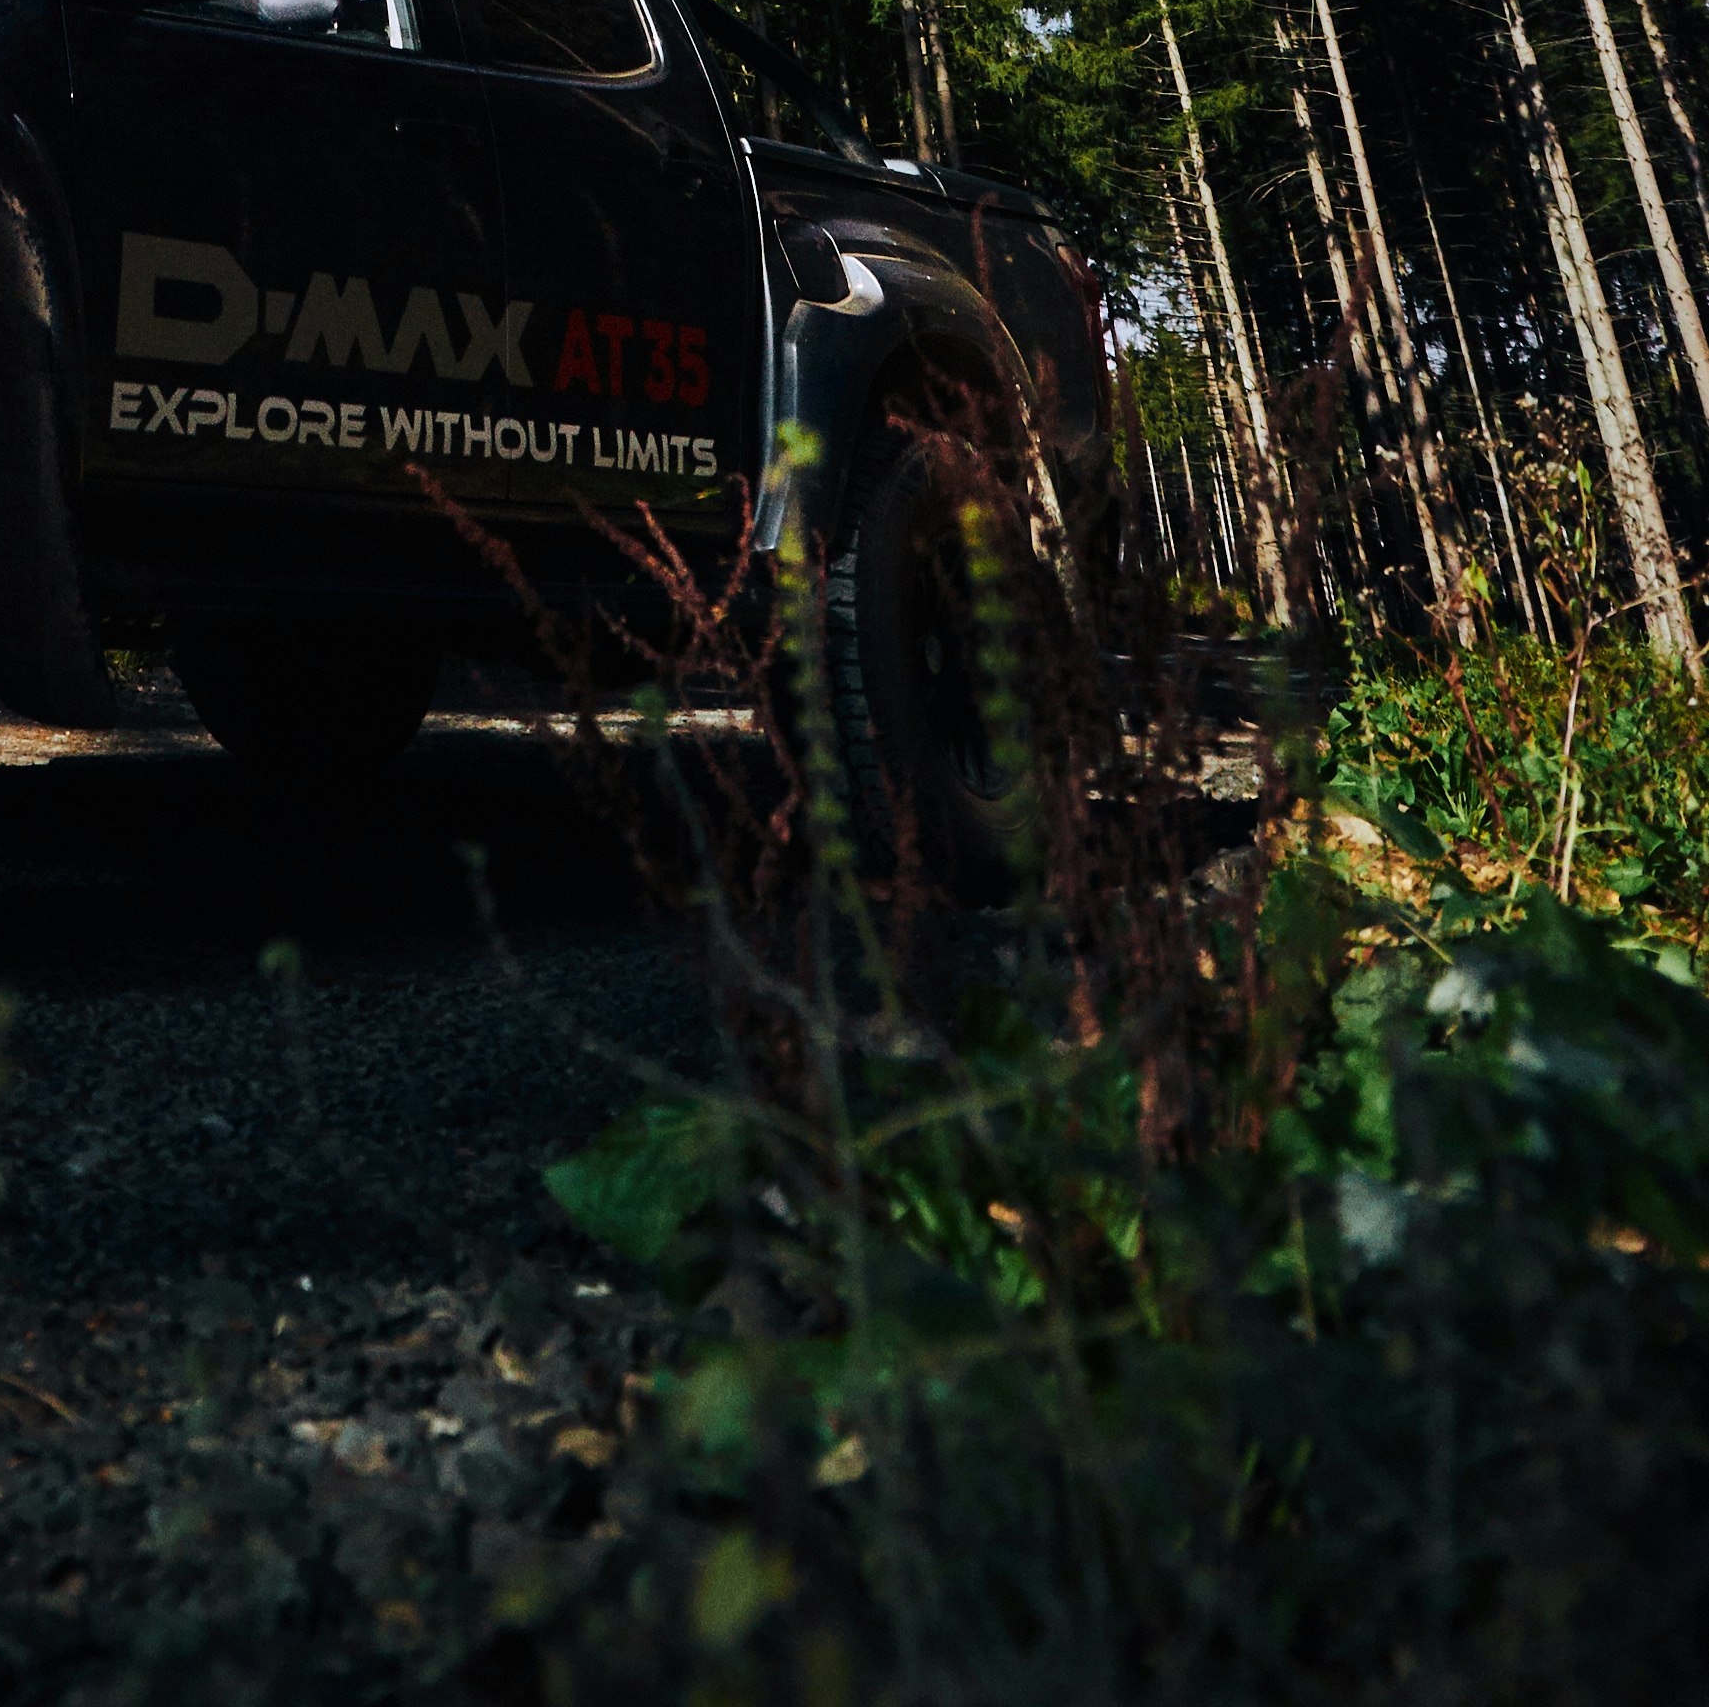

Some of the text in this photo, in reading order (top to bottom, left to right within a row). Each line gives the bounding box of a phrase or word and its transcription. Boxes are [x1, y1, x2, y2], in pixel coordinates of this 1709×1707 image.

[115, 231, 535, 389] D-MAX
[109, 380, 718, 478] EXPLORE WITHOUT LIMITS
